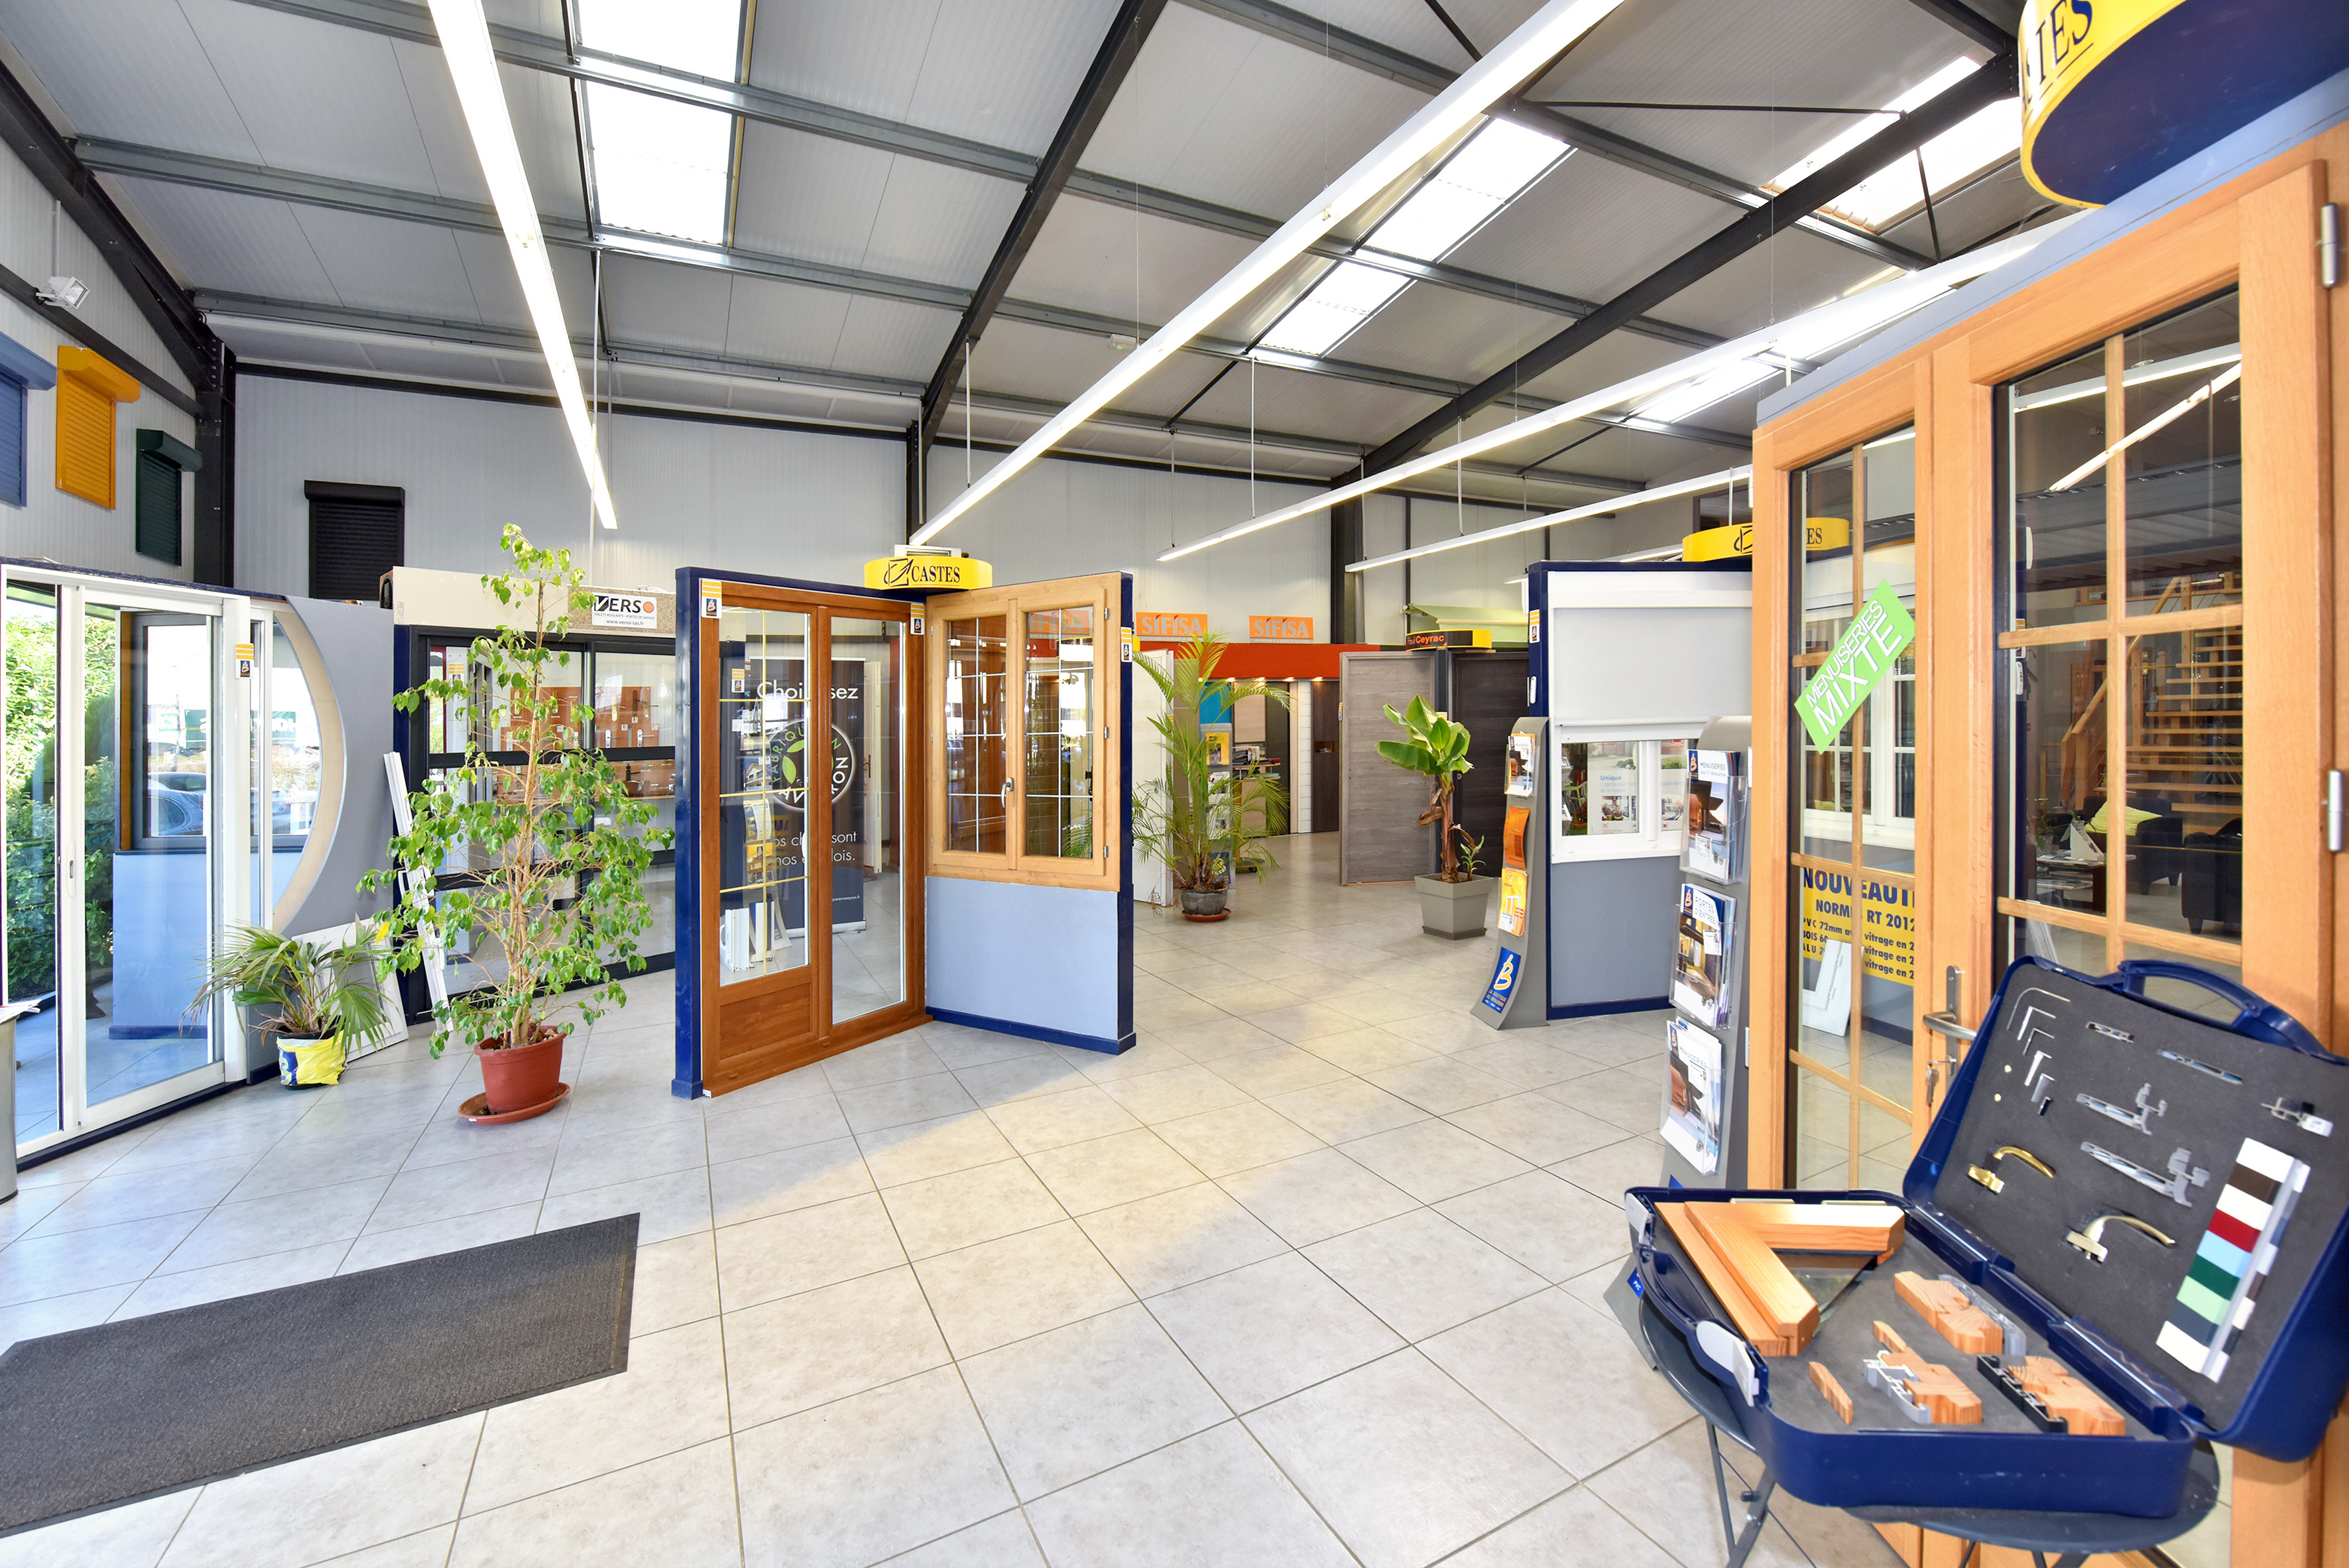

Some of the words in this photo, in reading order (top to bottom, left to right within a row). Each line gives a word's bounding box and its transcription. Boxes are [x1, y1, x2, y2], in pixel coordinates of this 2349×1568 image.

[911, 565, 961, 583] CASTES
[594, 595, 654, 613] VERSO
[1415, 634, 1445, 644] Ceyrac
[1806, 599, 1884, 709] MENUISERIES
[1813, 613, 1903, 735] MIXTE
[831, 831, 857, 843] sont
[1816, 899, 1852, 918] NORM
[1867, 910, 1882, 924] RT
[1819, 922, 1842, 934] 72mm
[1864, 932, 1894, 946] vitrage
[1896, 939, 1907, 949] en
[1864, 946, 1894, 960] vitrage
[1896, 953, 1907, 963] en
[1864, 960, 1894, 974] vitrage
[1896, 967, 1907, 977] en
[1633, 1280, 1642, 1291] PVC
